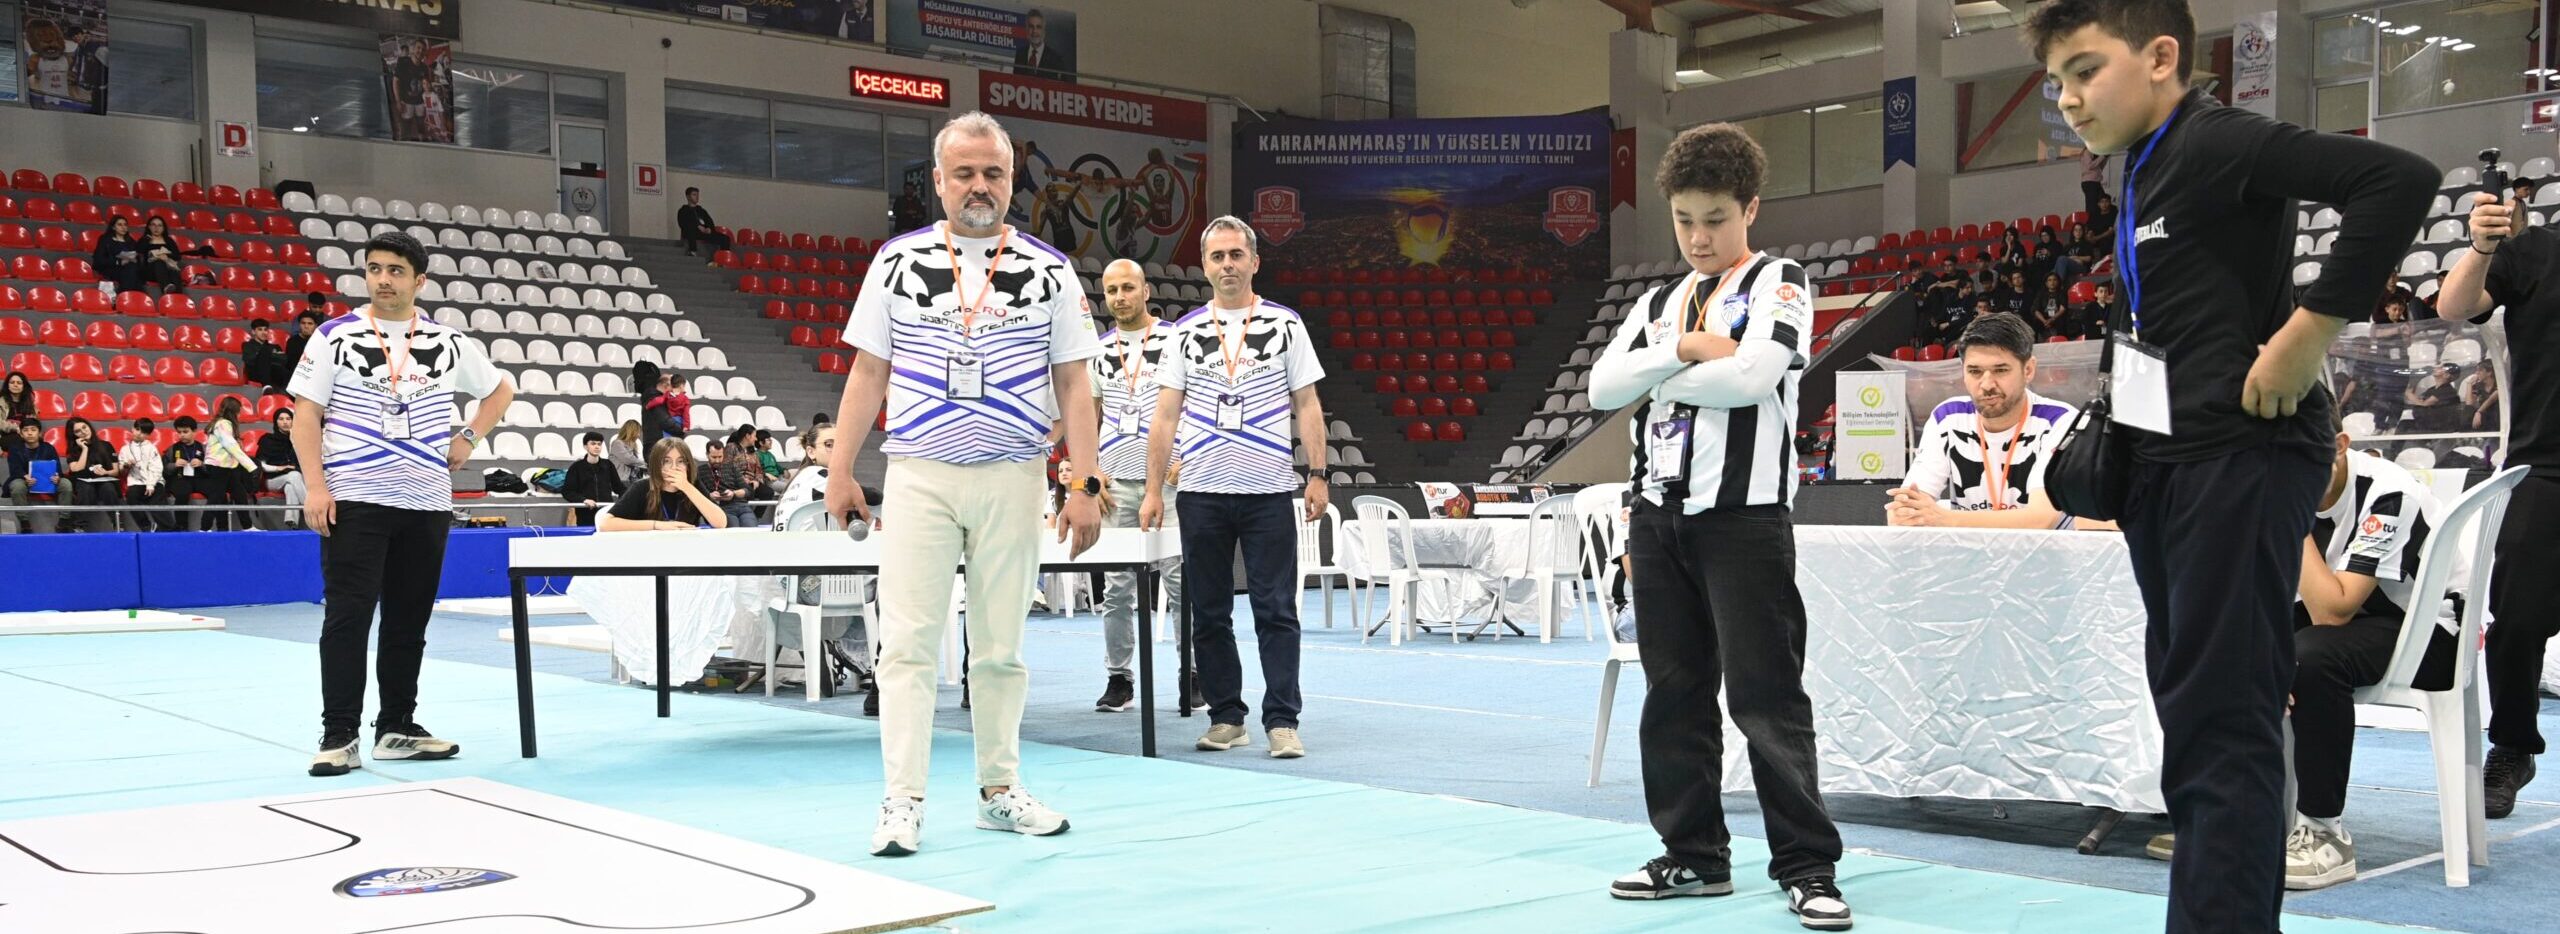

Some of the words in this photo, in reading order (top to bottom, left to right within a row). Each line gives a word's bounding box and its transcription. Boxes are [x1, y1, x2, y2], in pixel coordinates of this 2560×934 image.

[924, 1, 976, 17] MÜSABAKALARA
[977, 10, 1004, 21] KATILAN
[1004, 14, 1018, 24] TÜM
[926, 13, 952, 25] SPORCU
[953, 17, 962, 27] VE
[962, 19, 1013, 35] ANTRENÖRLERE
[925, 24, 977, 42] BAŞARILAR
[978, 31, 1017, 48] DİLERİM.
[855, 70, 943, 101] İÇECEKLER
[989, 81, 1044, 112] SPOR
[1049, 90, 1087, 117] HER
[1091, 96, 1154, 126] YERDE
[224, 124, 247, 148] D
[1259, 134, 1430, 153] KAHRAMANMARAŞ'IN
[1437, 133, 1521, 150] YÜKSELEN
[1527, 134, 1592, 151] YILDIZI
[1276, 155, 1349, 165] KAHRAMANMARAŞ
[1446, 155, 1468, 164] SPOR
[1471, 155, 1497, 164] KADIN
[1500, 155, 1542, 164] VOLEYBOL
[639, 166, 657, 187] D
[975, 314, 1028, 334] TEAM
[1235, 365, 1270, 384] TEAM
[407, 383, 440, 401] TEAM
